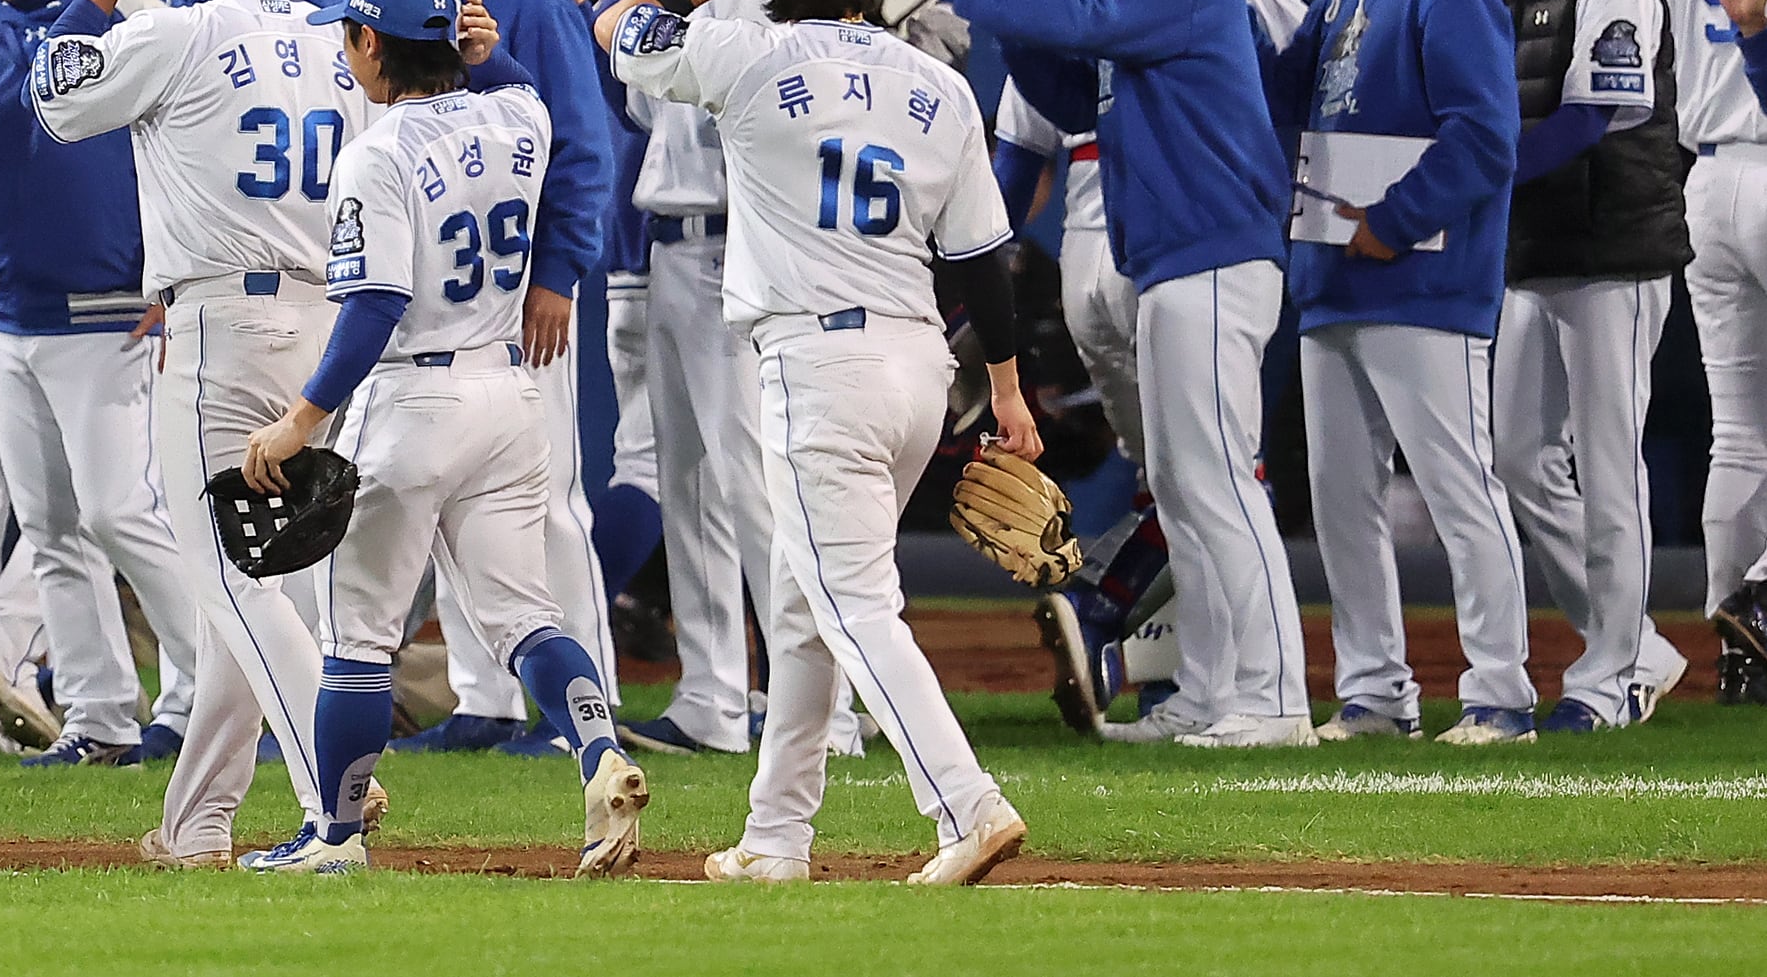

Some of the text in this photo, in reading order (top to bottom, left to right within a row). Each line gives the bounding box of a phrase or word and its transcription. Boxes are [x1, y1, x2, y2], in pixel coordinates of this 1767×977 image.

[777, 73, 941, 135] 류지혁
[235, 106, 346, 203] 30
[417, 135, 536, 204] 김성윤
[817, 136, 906, 237] 16
[438, 197, 532, 305] 39
[577, 703, 608, 722] 39
